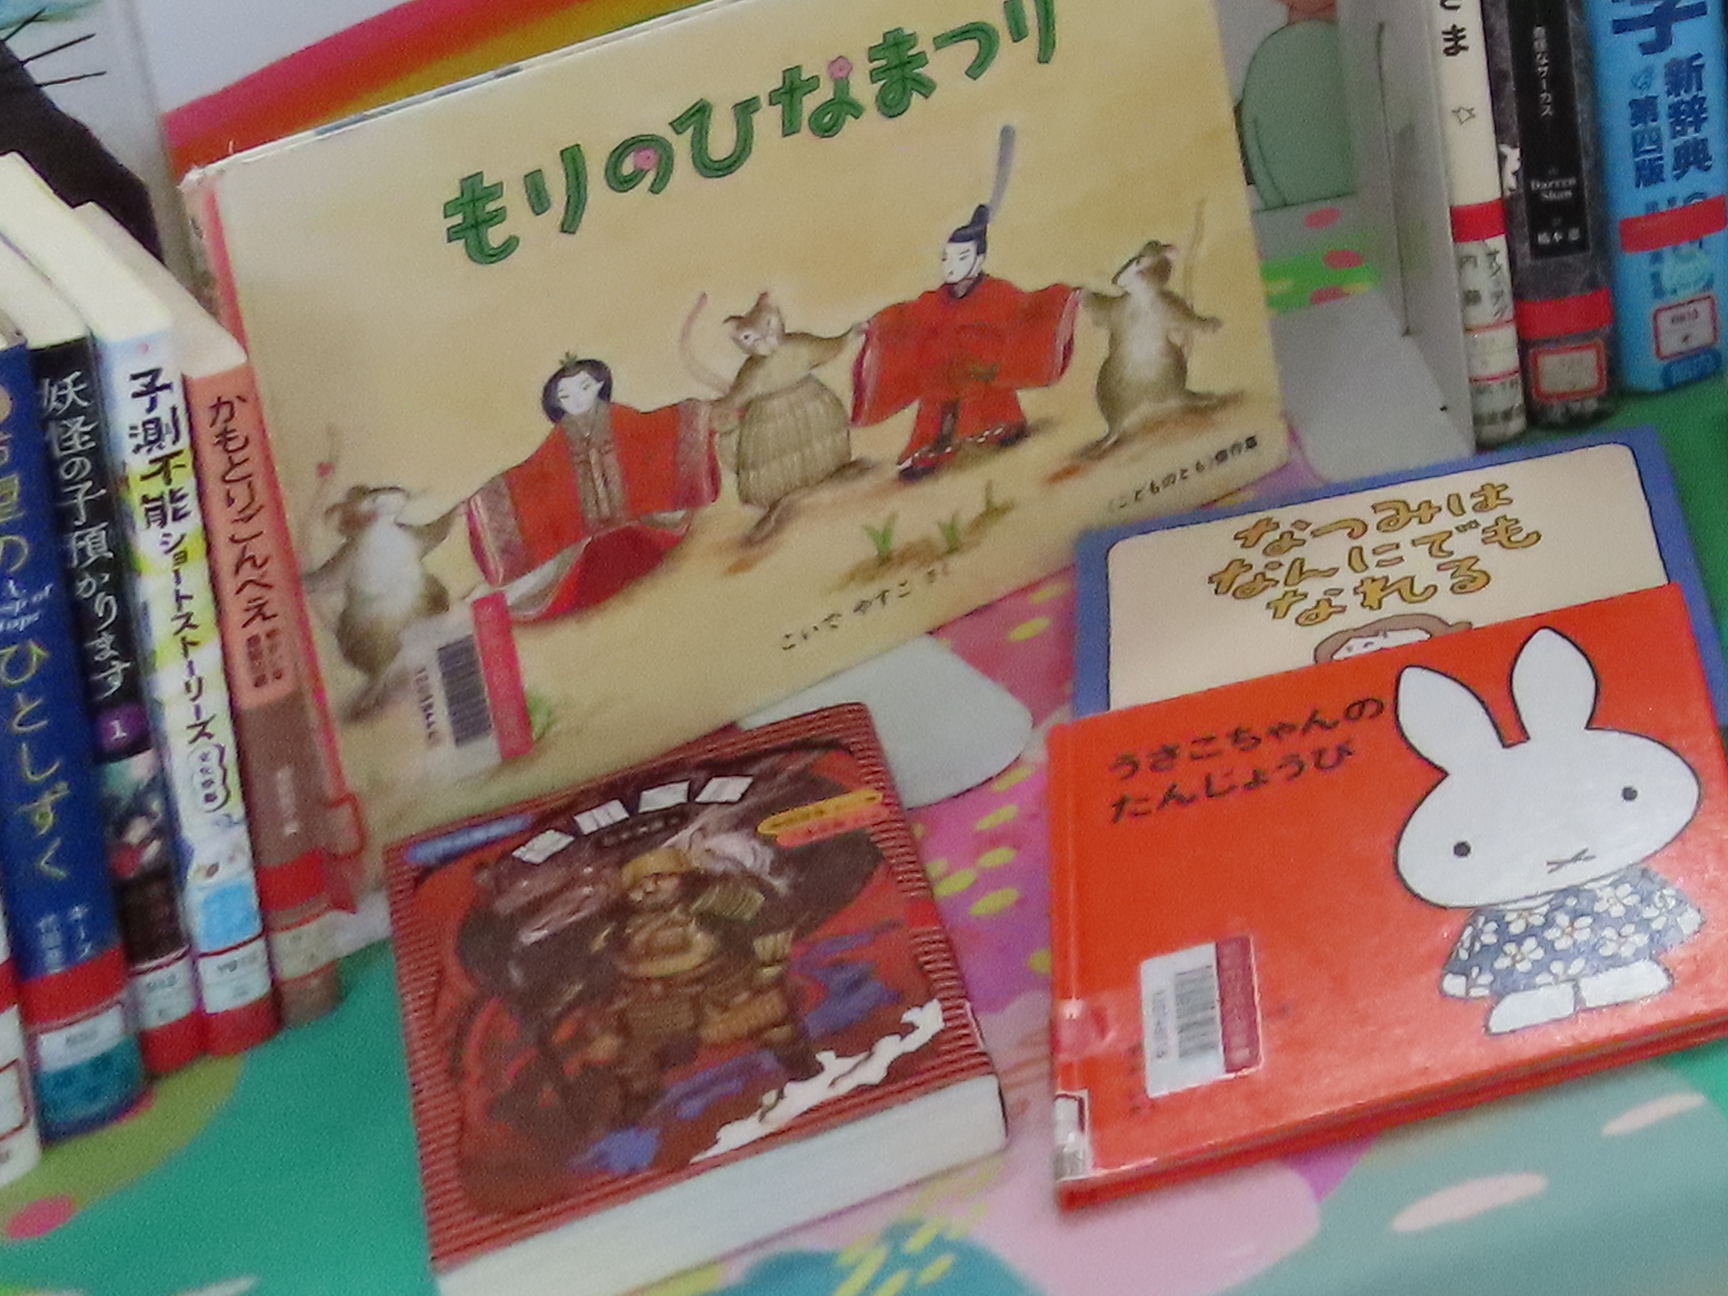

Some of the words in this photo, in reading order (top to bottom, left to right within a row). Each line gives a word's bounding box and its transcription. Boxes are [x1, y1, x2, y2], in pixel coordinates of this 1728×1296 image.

[128, 368, 192, 532] 予測不能
[38, 370, 140, 696] 妖怪の子預かります
[207, 392, 277, 630] かもとりごんべえ
[1234, 483, 1512, 557] なつみは
[1207, 515, 1543, 600] なんにでも
[1266, 561, 1493, 627] なれる
[158, 526, 220, 752] ショートストーリーズ
[1107, 695, 1387, 782] うさこちゃんの
[1109, 738, 1356, 825] たんじょうび
